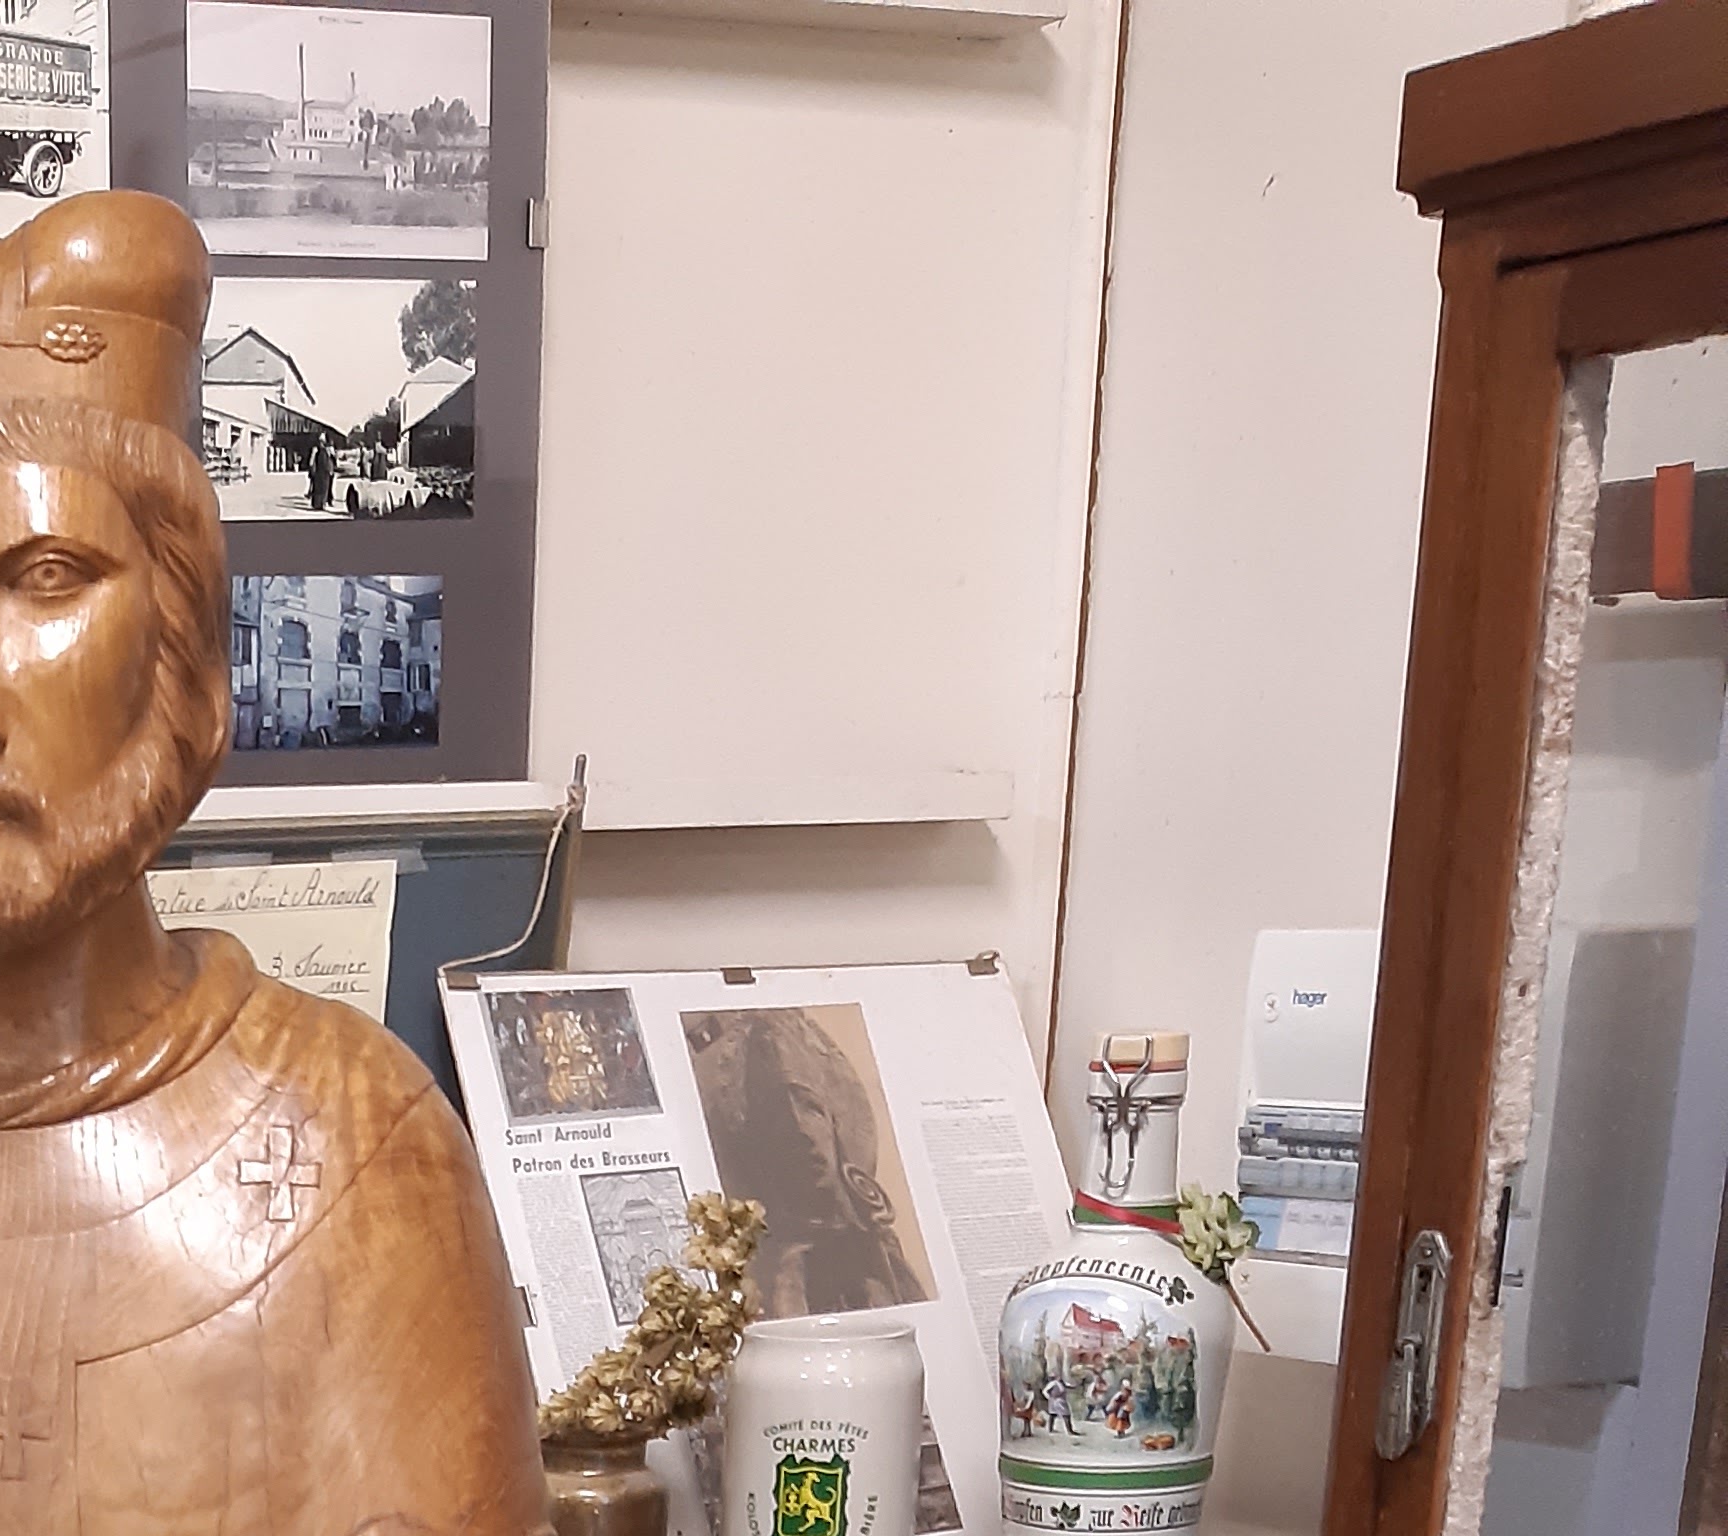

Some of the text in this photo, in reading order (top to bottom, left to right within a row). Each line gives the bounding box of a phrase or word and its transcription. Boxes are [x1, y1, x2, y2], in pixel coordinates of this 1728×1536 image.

[38, 71, 51, 93] DE
[51, 69, 89, 97] VITTEL
[1292, 988, 1328, 1008] hager
[505, 1122, 613, 1147] Saint Arnould
[512, 1151, 672, 1174] Patron des Brasseurs
[809, 1419, 833, 1432] DES
[771, 1436, 857, 1454] CHARMES
